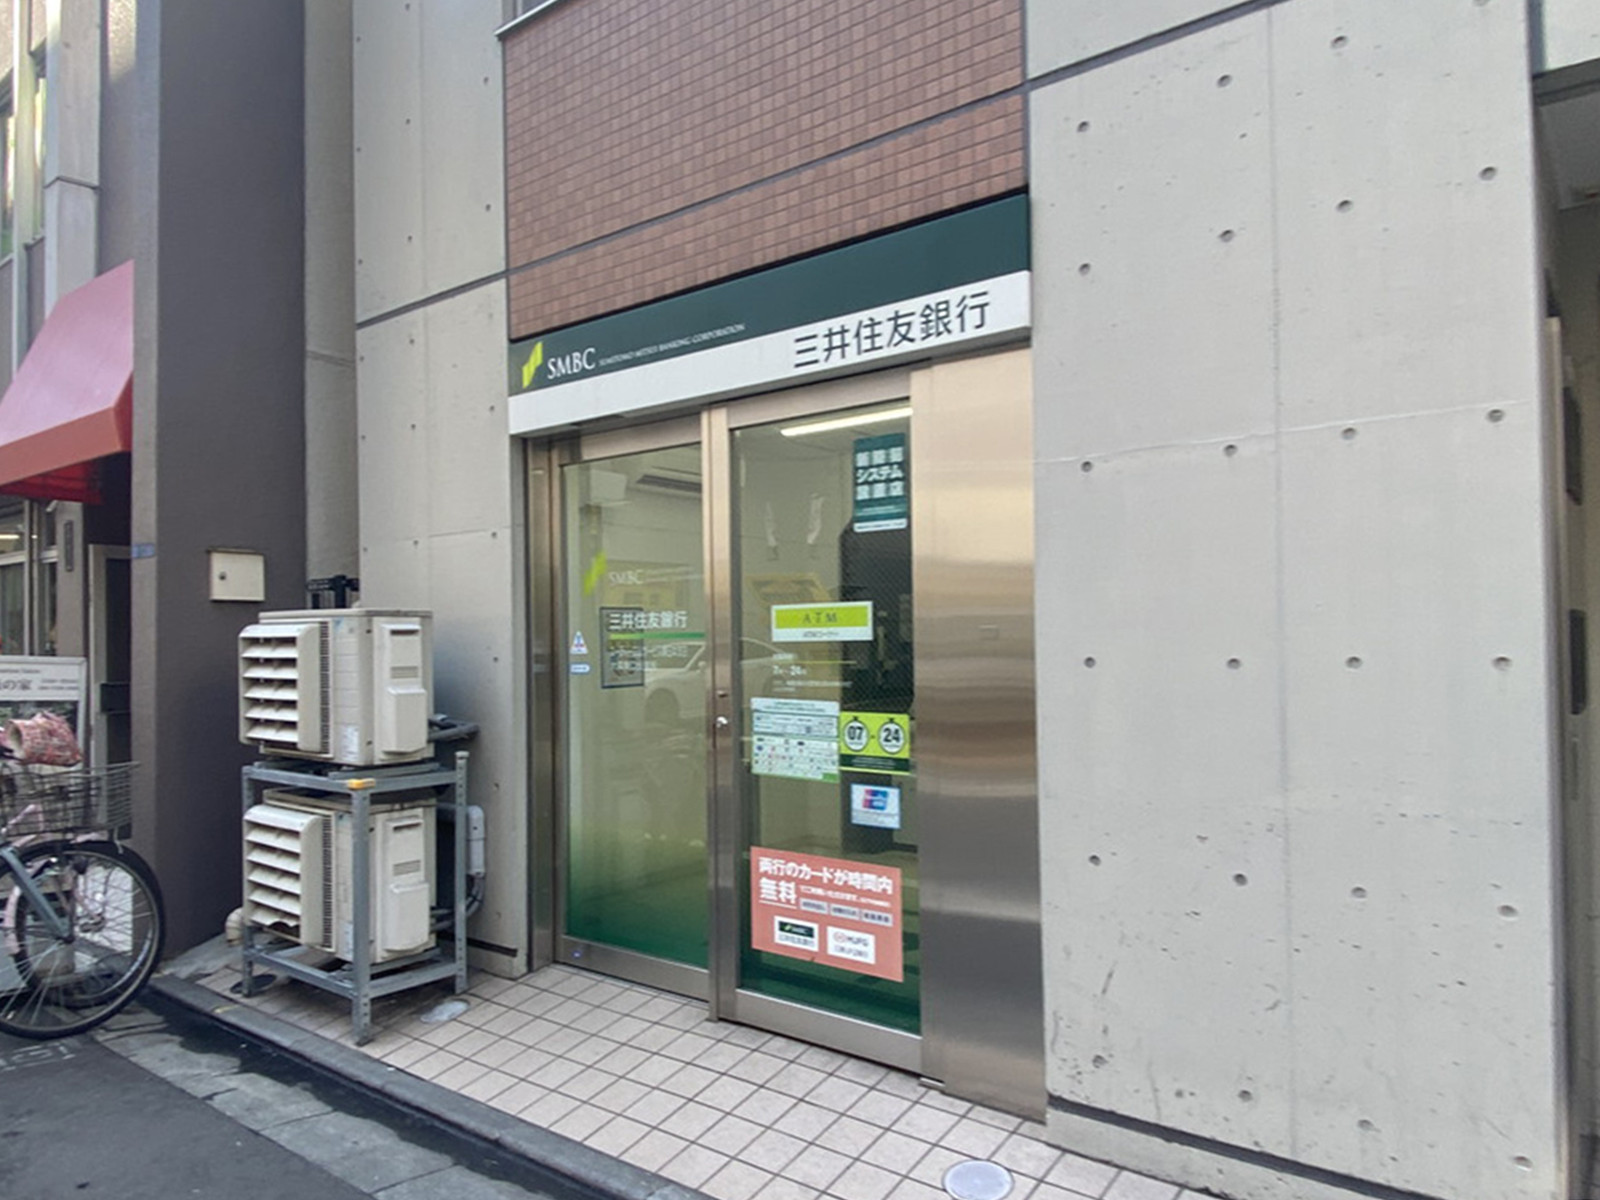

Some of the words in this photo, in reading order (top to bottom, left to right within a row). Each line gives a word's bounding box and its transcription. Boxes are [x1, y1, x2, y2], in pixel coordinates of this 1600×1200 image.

[794, 290, 990, 368] 三井住友銀行
[547, 347, 596, 380] SMBC
[608, 610, 688, 631] 三井住友銀行
[847, 725, 864, 741] 07
[883, 728, 902, 743] 24
